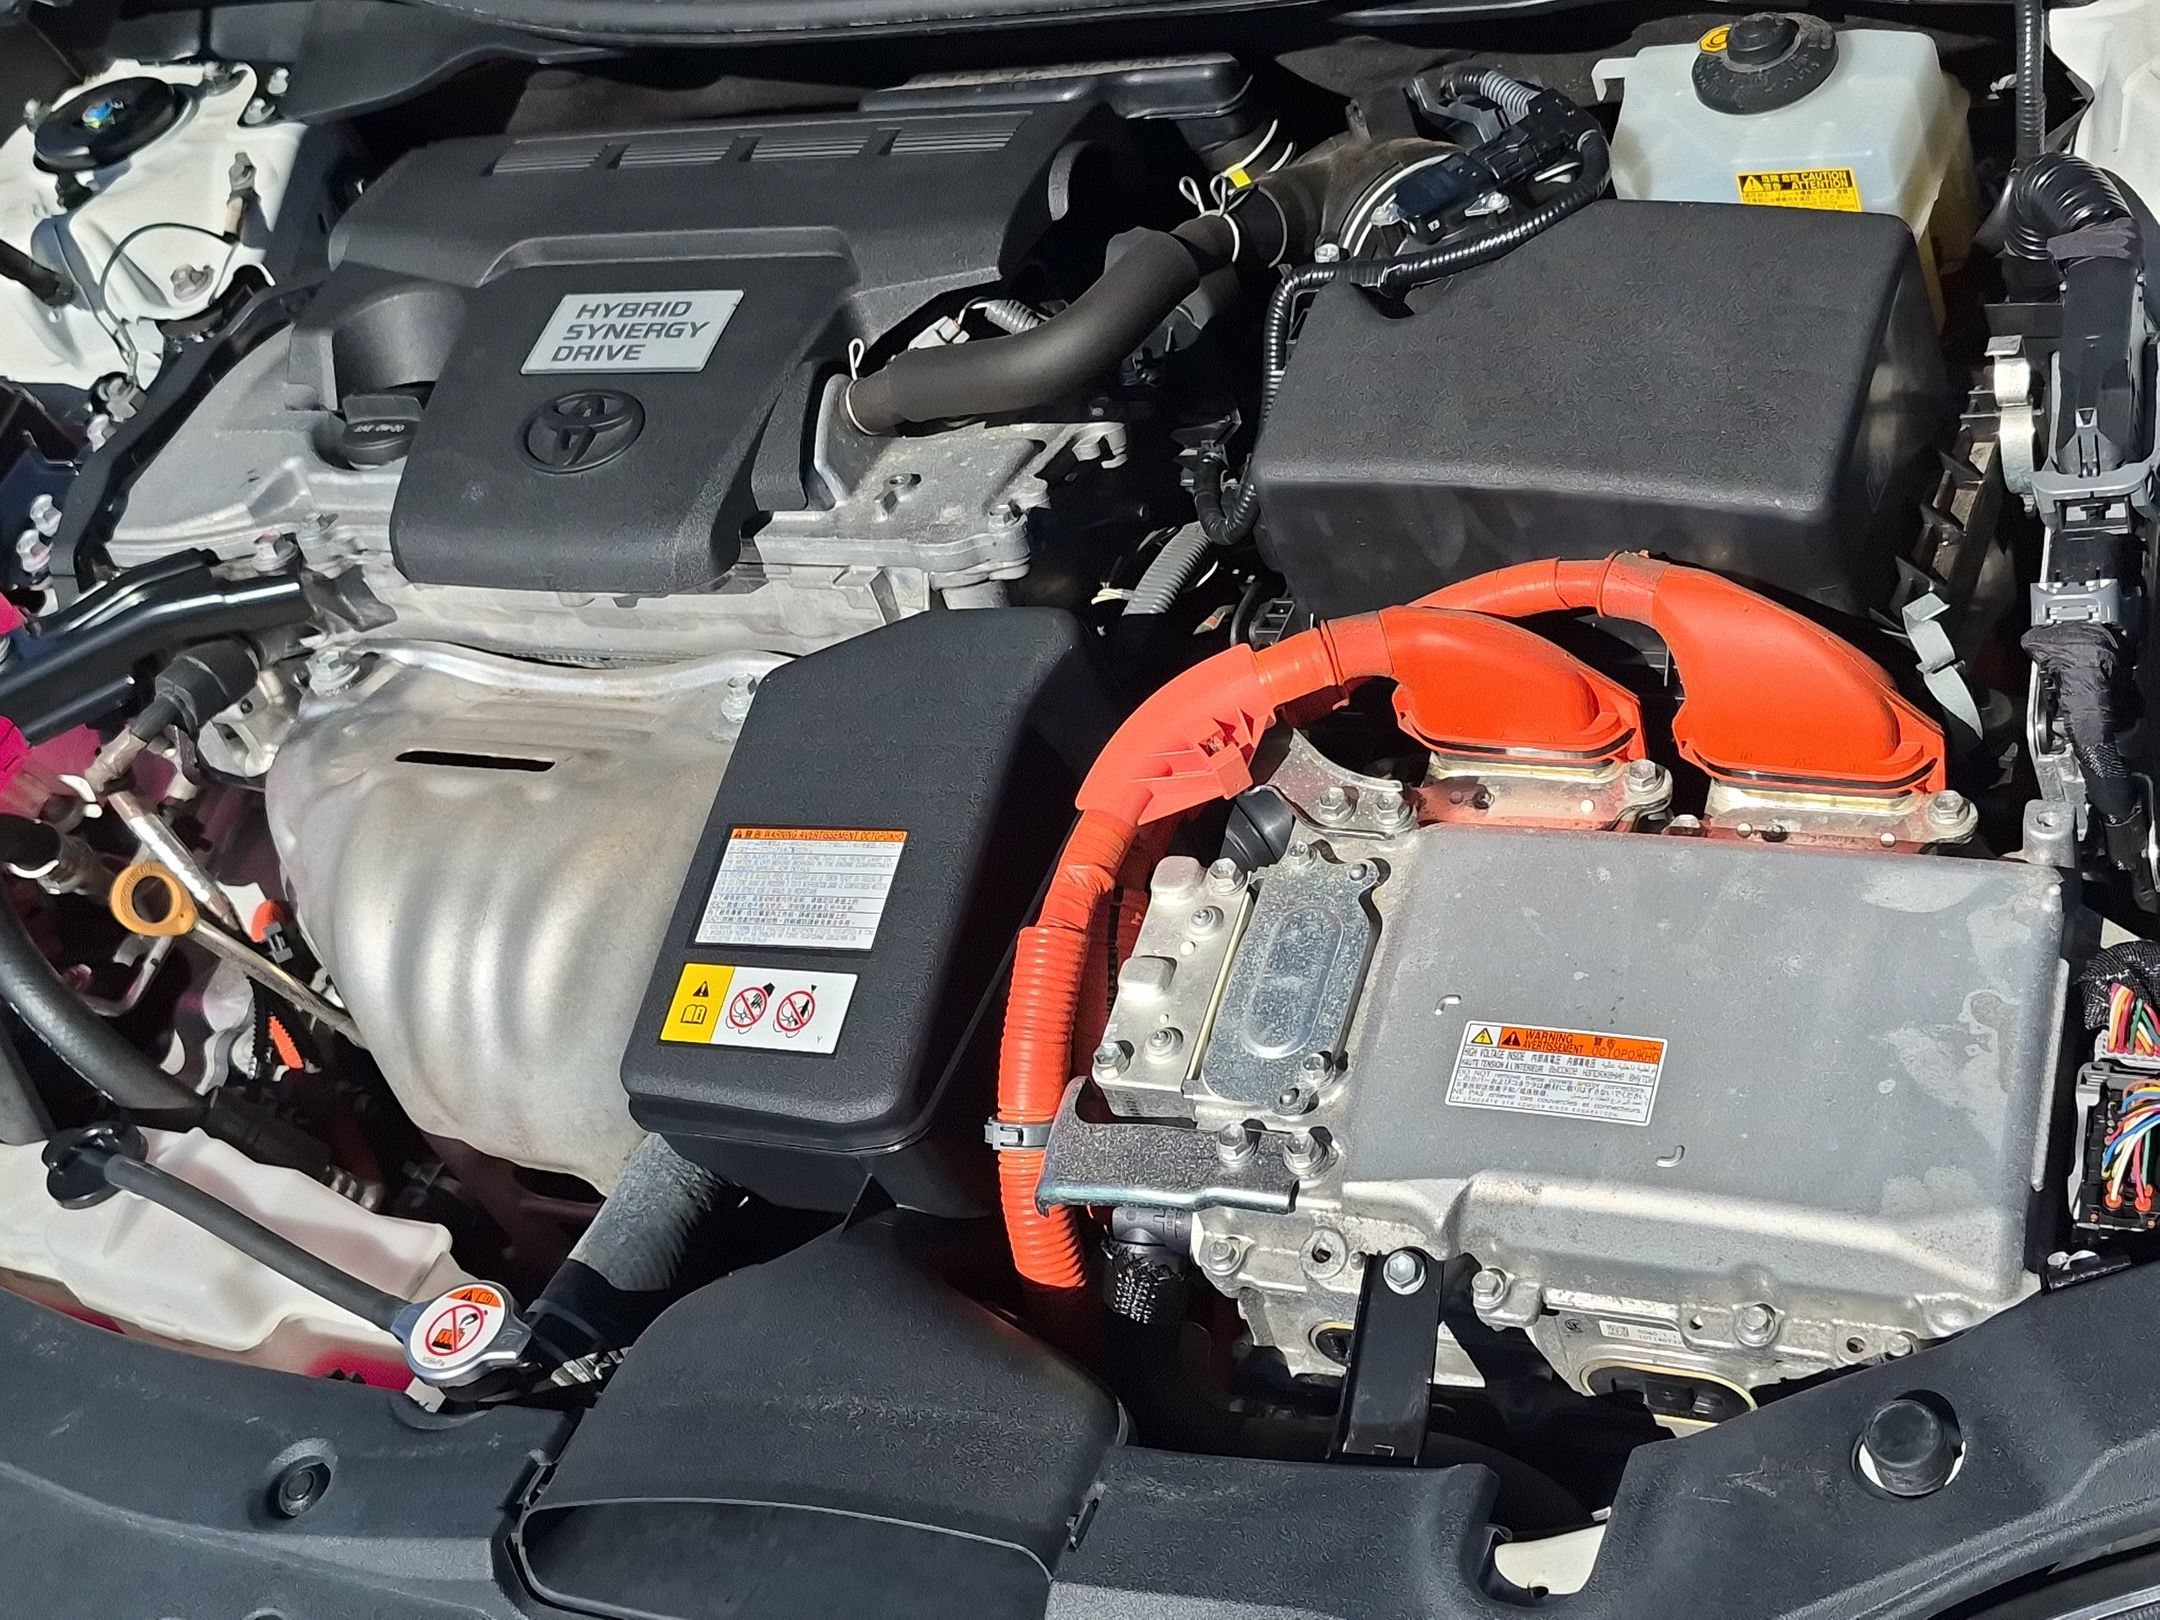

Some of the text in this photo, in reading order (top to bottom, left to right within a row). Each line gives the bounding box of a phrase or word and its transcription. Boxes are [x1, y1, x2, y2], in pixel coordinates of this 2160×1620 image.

[1801, 171, 1847, 181] CAUTION
[1791, 179, 1849, 190] ATTENTION
[575, 301, 693, 319] HYBRID
[562, 321, 711, 340] SYNERGY
[551, 344, 646, 362] DRIVE
[1525, 1030, 1574, 1044] WARNING
[1522, 1040, 1585, 1054] AVERTISSEMENT
